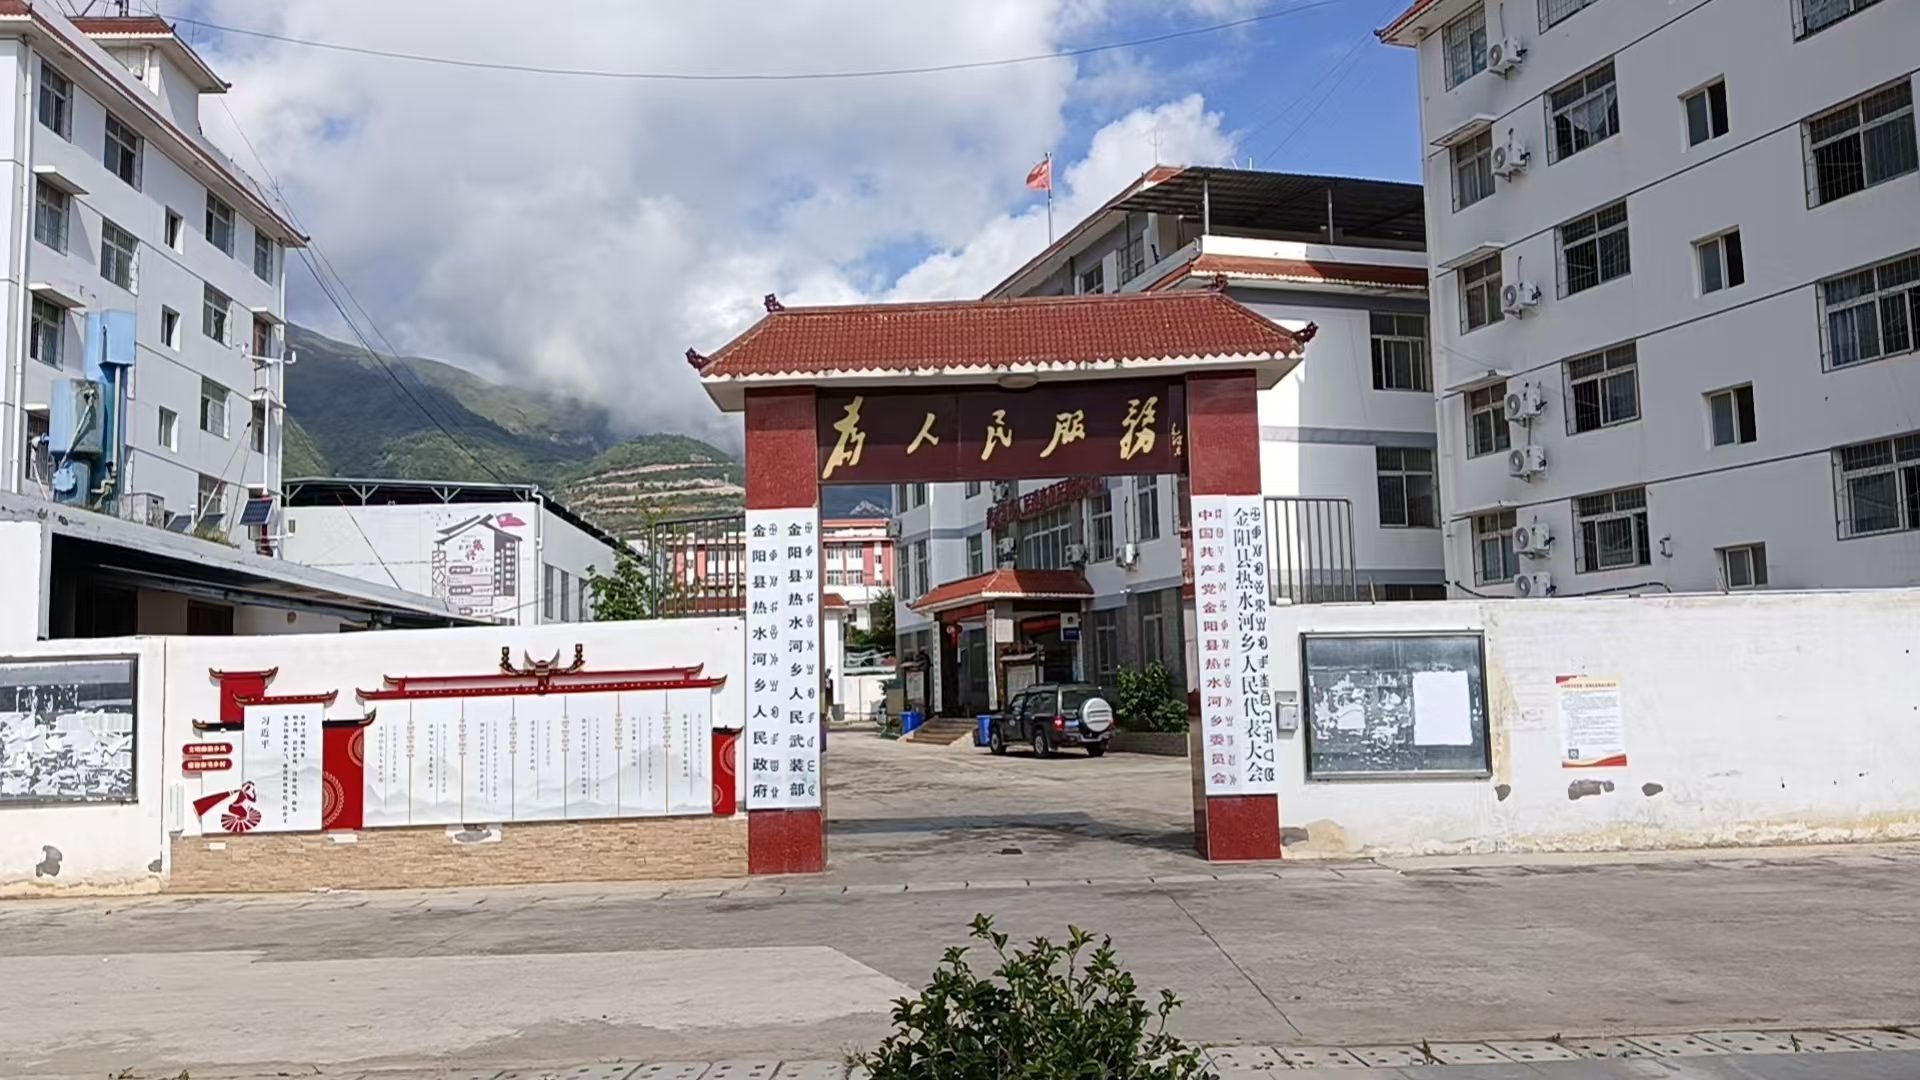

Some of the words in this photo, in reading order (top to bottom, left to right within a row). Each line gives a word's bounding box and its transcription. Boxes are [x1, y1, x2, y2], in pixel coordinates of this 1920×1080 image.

[260, 715, 270, 750] 习近平
[752, 523, 768, 799] 金阳县热水河乡人民政府
[788, 522, 805, 797] 金阳县热水河乡人民武装部
[1198, 508, 1227, 784] 中国共产党金阳县热水河乡委员会
[1233, 507, 1263, 783] 金阳县热水河乡人民代表大会
